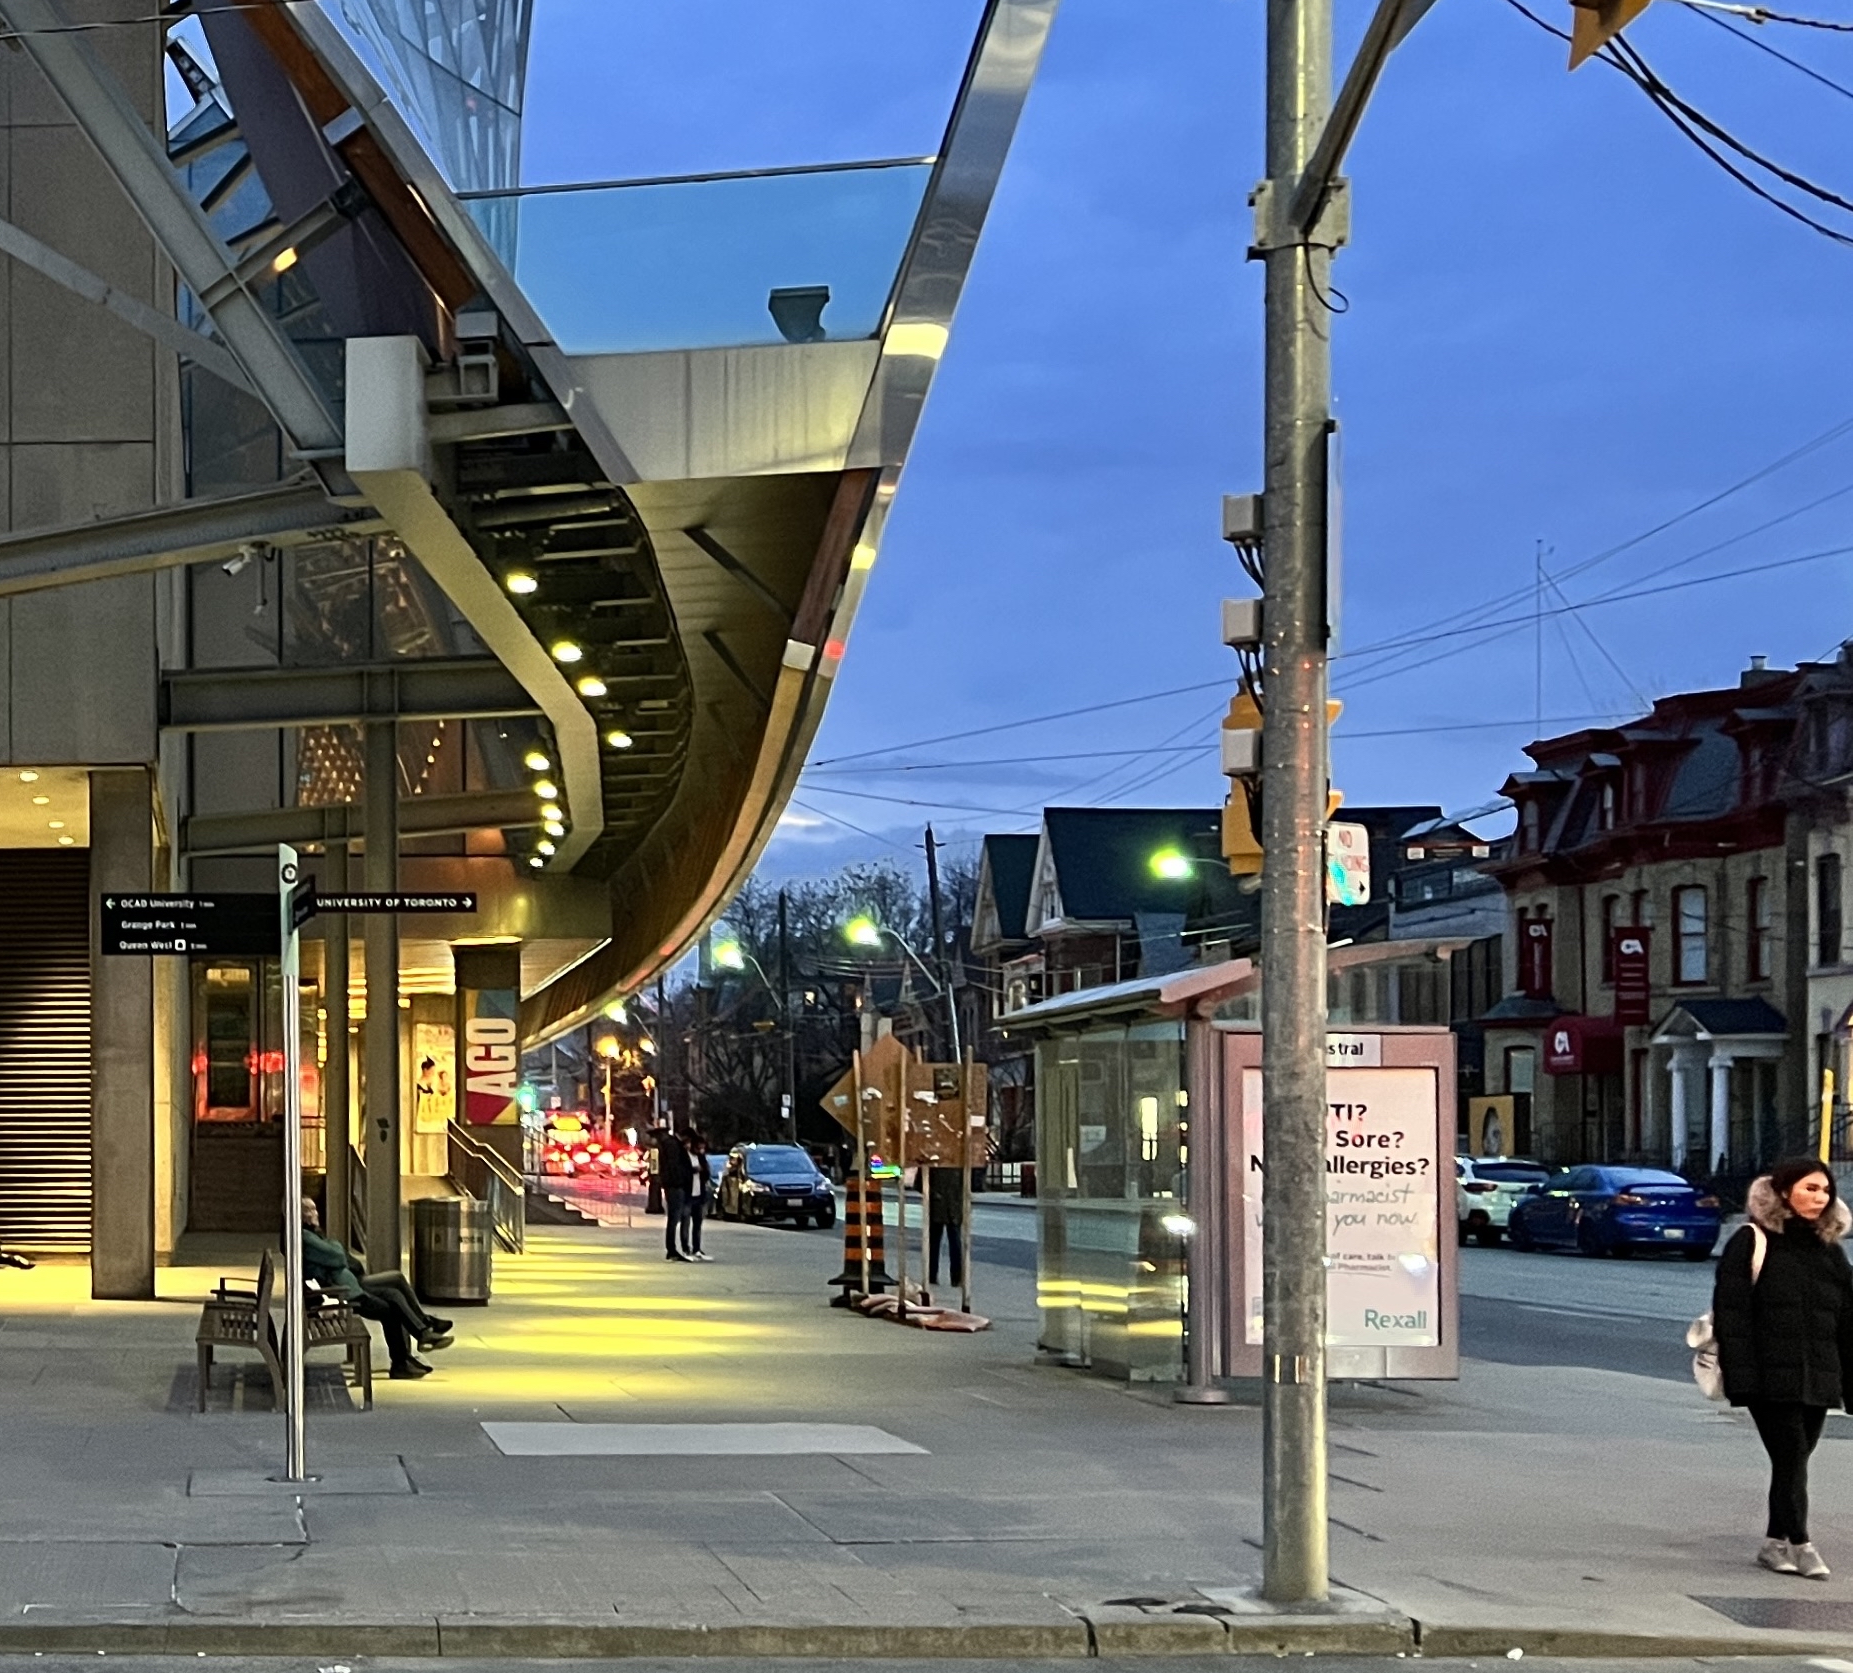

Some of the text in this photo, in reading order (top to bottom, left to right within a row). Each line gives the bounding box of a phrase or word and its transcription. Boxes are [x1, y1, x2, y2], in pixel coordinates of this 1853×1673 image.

[120, 899, 148, 909] OCAD
[150, 899, 195, 910] University
[316, 898, 457, 908] UNIVERSITY OF TORONTO
[155, 920, 175, 929] Park
[150, 941, 173, 950] West
[465, 1018, 517, 1099] AGO
[1326, 1104, 1368, 1122] TI?
[1336, 1130, 1405, 1148] Sore?
[1327, 1183, 1415, 1204] armacist
[1332, 1212, 1367, 1236] you
[1364, 1309, 1427, 1330] Rexall
